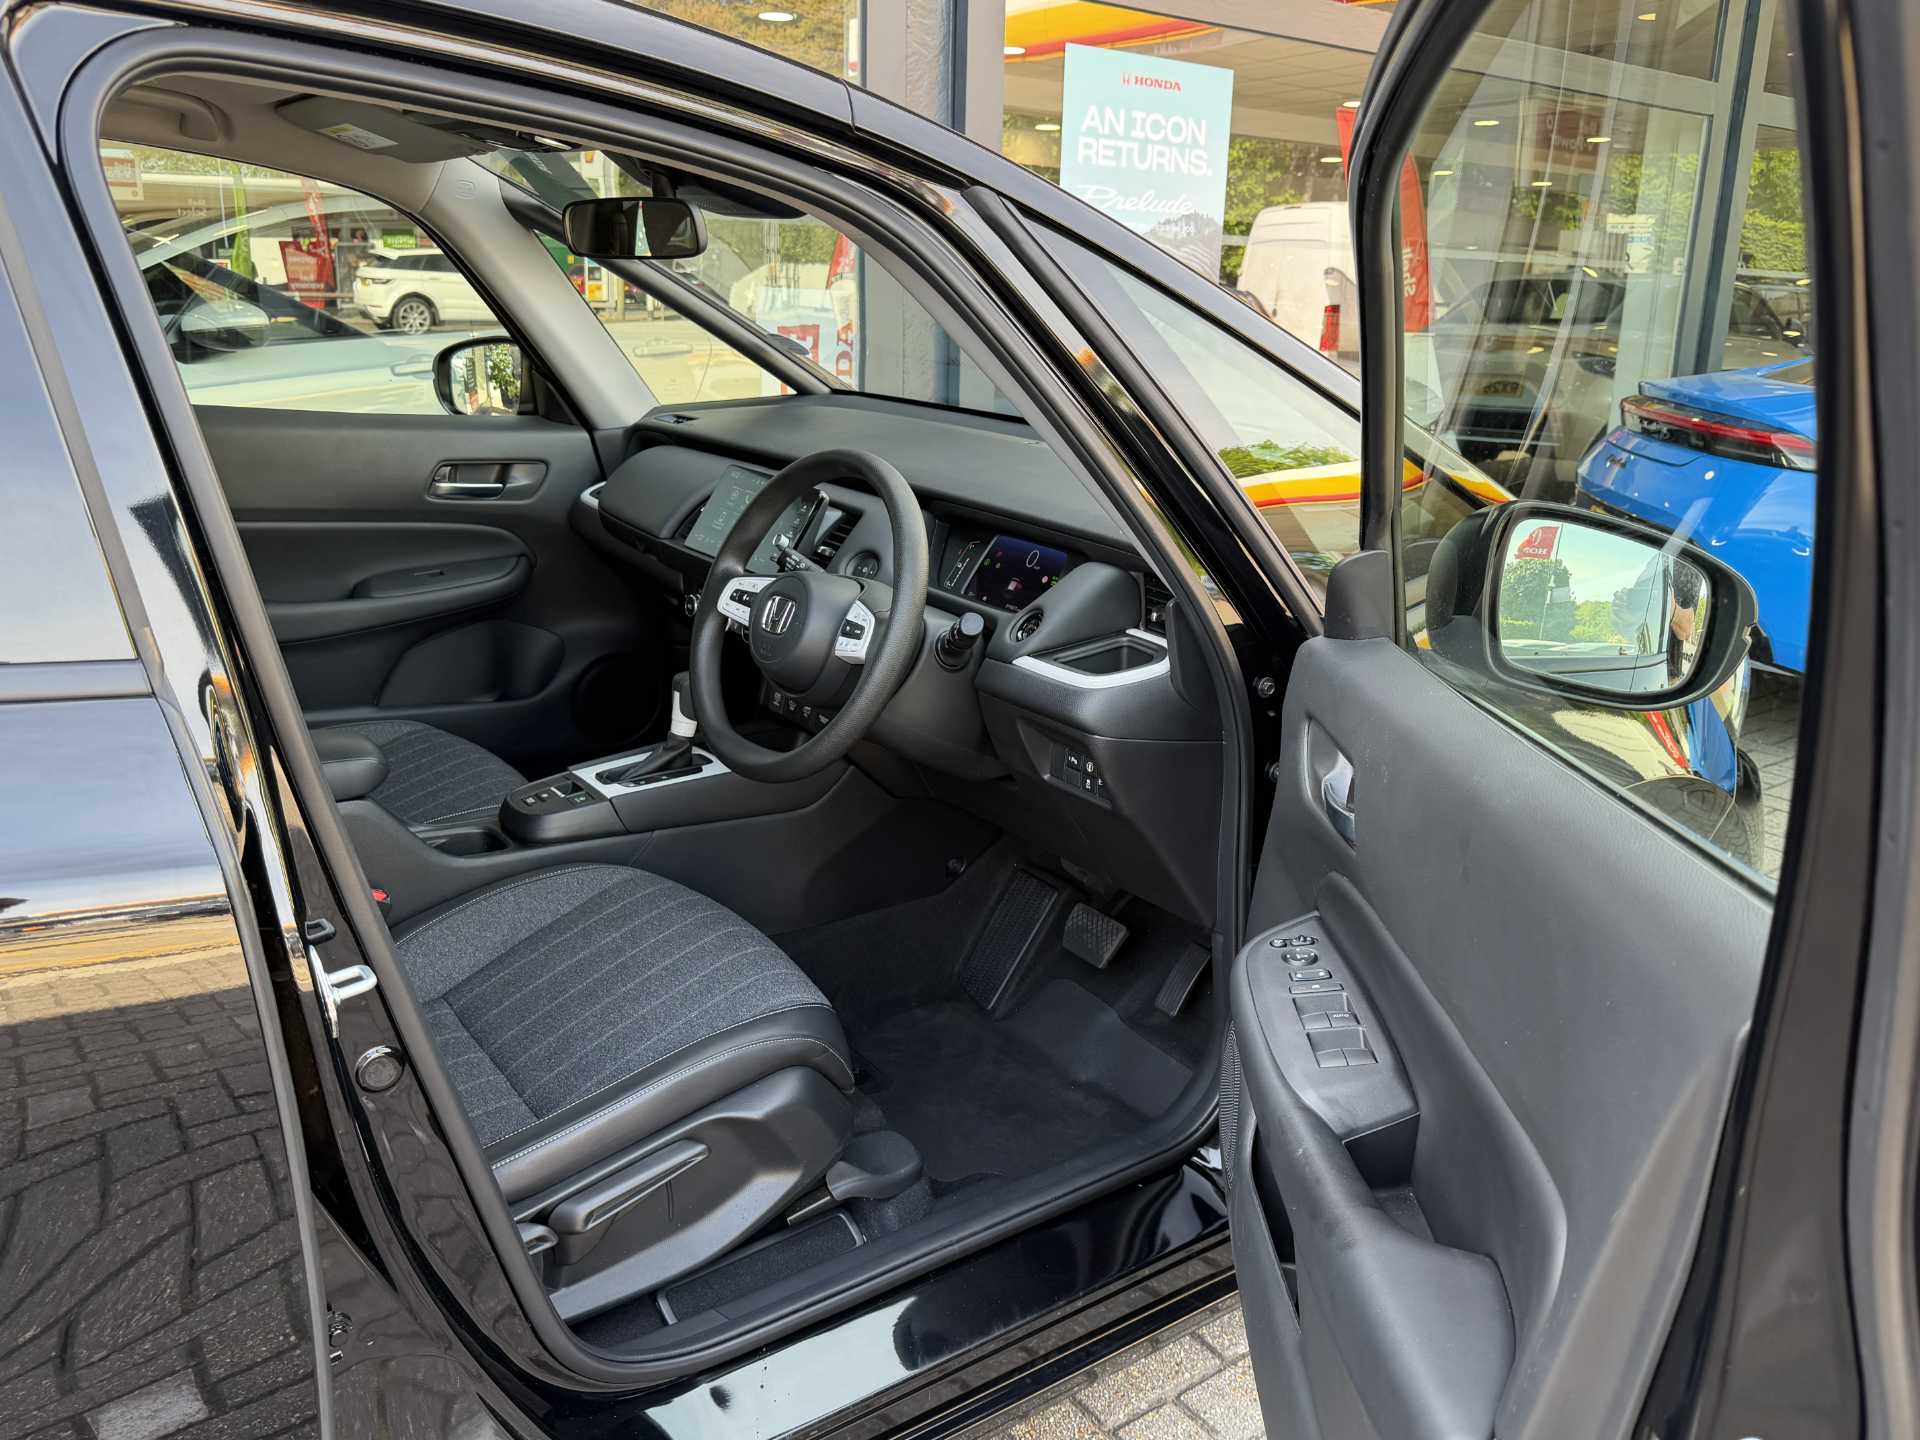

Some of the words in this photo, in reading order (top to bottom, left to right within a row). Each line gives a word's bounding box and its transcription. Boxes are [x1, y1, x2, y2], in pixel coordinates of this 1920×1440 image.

[1135, 75, 1182, 92] HONDA
[1080, 104, 1126, 137] AN
[1130, 110, 1207, 145] ICON
[1077, 136, 1213, 177] RETURNS.
[1076, 183, 1196, 213] Prelude
